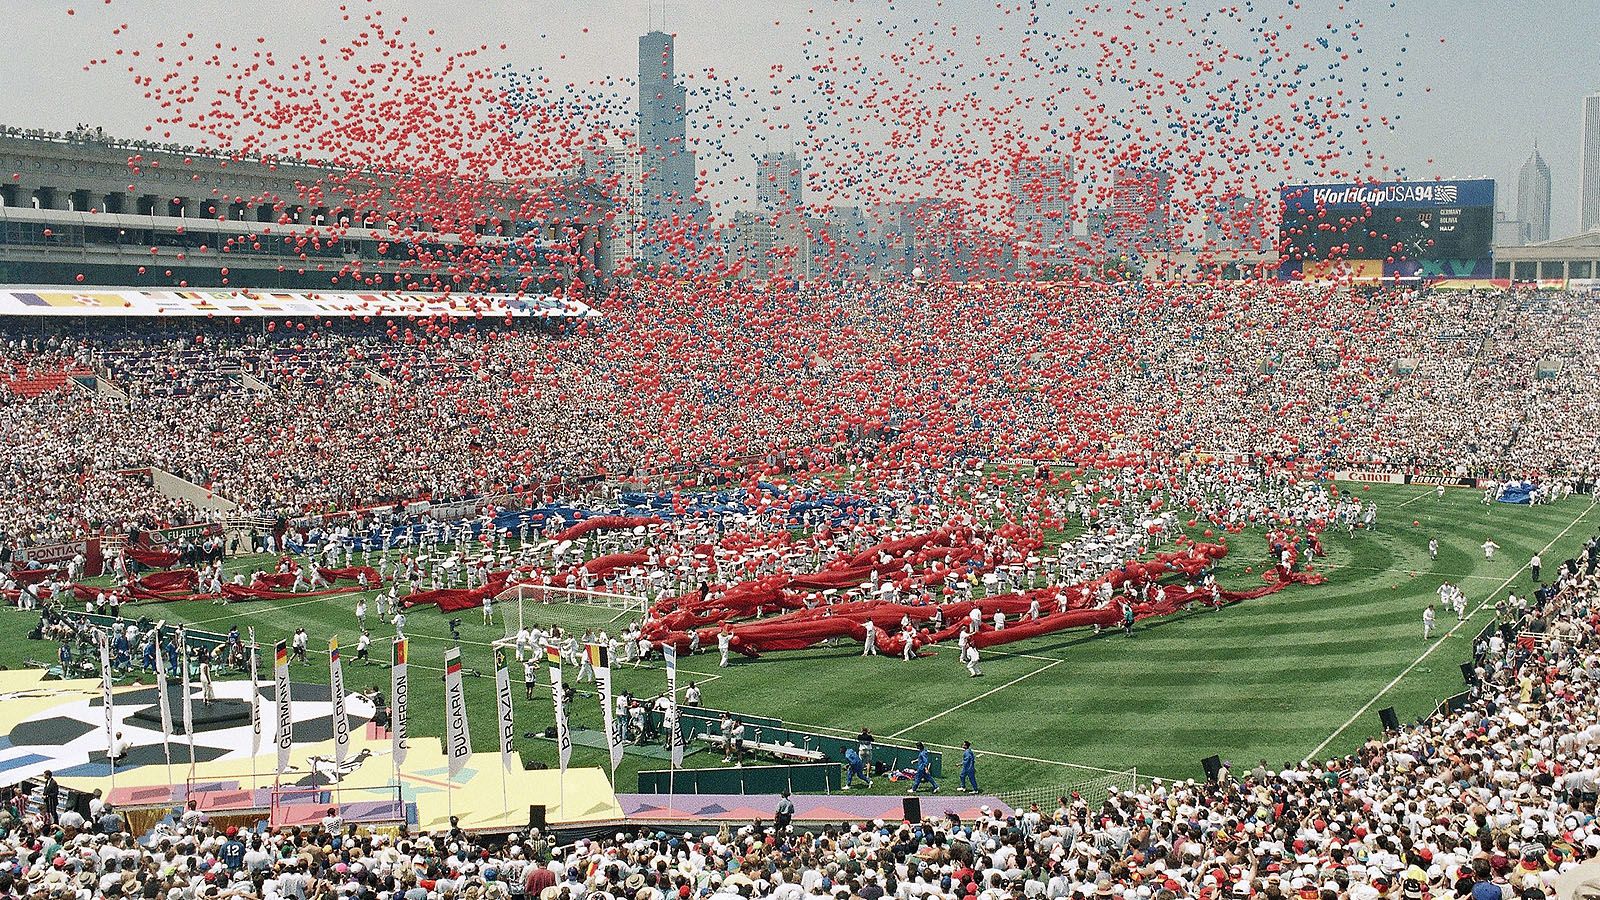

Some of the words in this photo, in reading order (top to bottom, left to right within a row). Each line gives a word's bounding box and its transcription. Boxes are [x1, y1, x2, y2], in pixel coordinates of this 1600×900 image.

[1348, 472, 1391, 482] Canon
[279, 676, 292, 750] GERMANY
[450, 682, 468, 758] BULGARIA
[226, 844, 240, 856] 12
